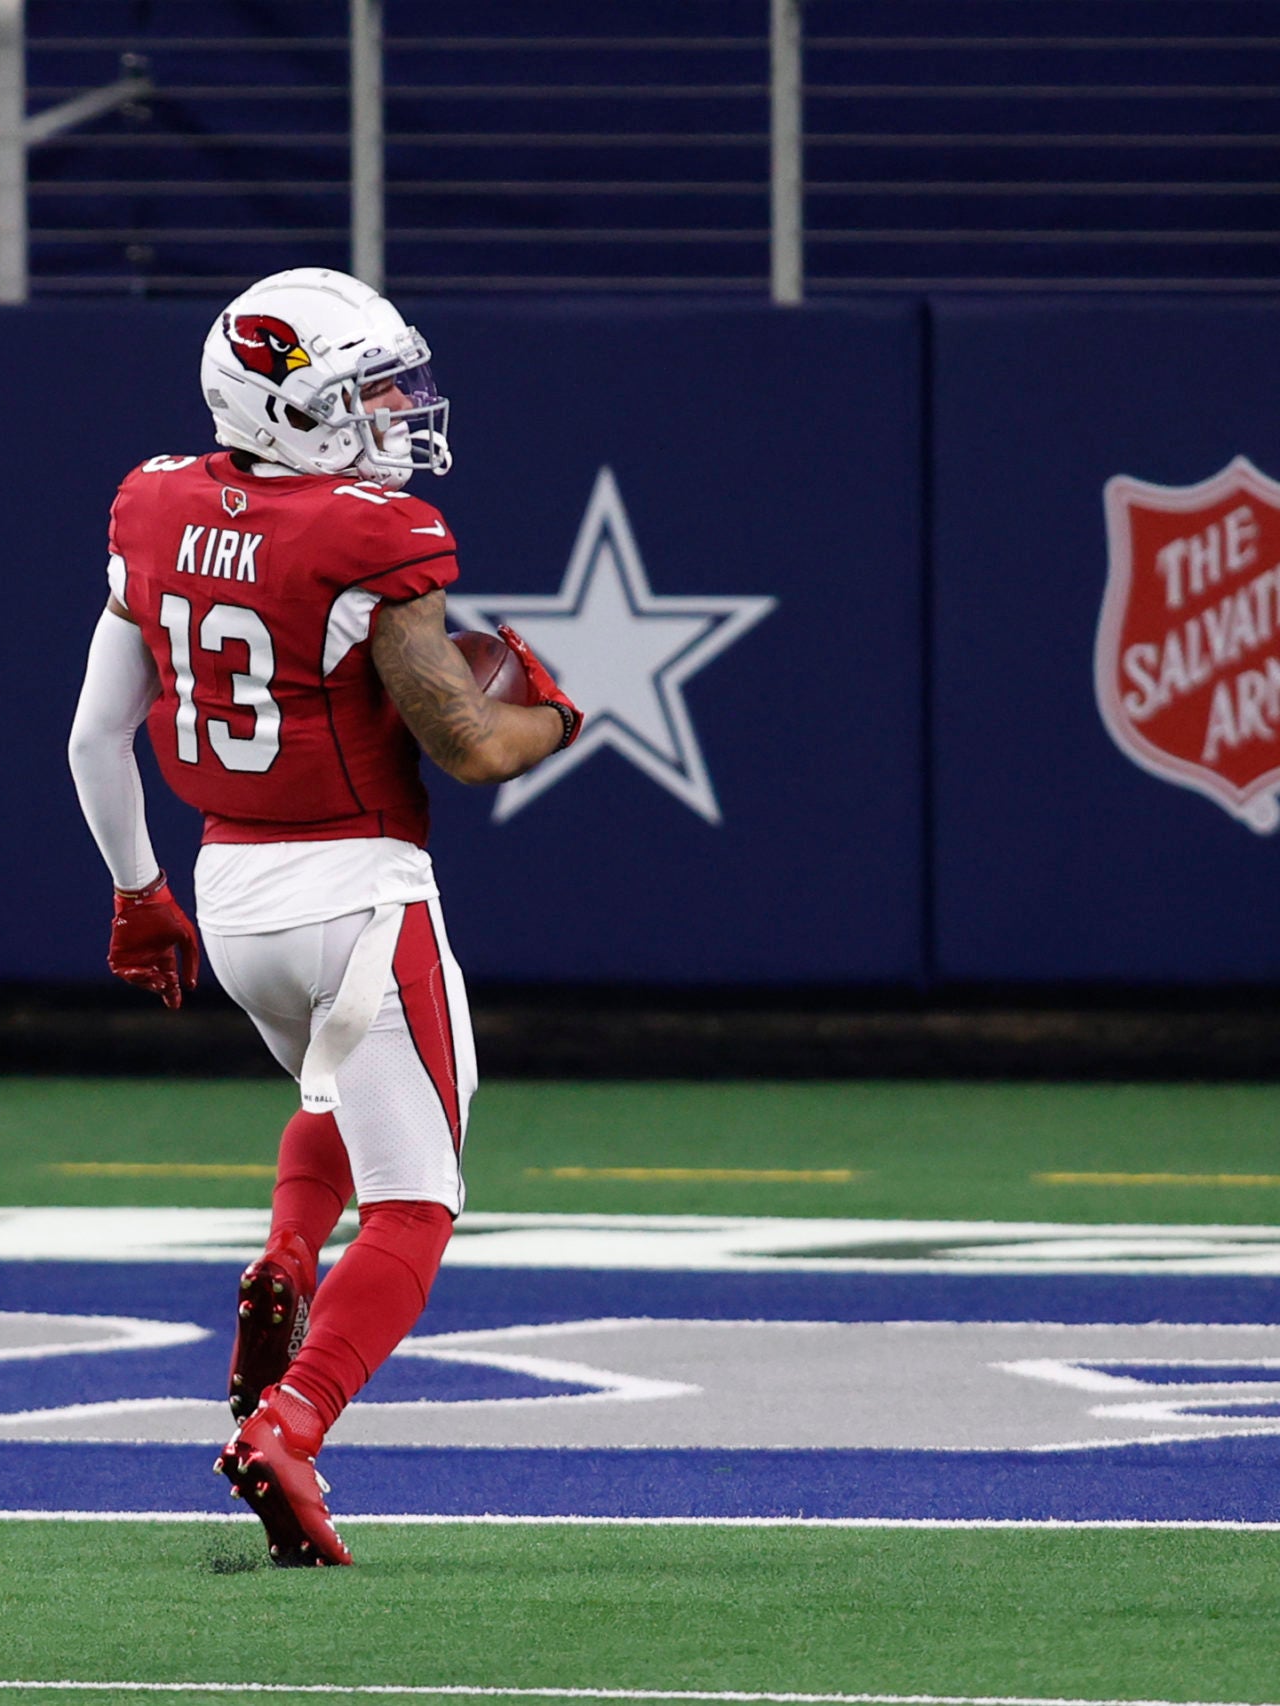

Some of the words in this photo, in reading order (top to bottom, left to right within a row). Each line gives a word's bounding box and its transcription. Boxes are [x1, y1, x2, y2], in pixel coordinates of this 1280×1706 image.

[175, 524, 263, 584] KIRK
[1156, 506, 1259, 607] THE
[160, 592, 283, 774] 13
